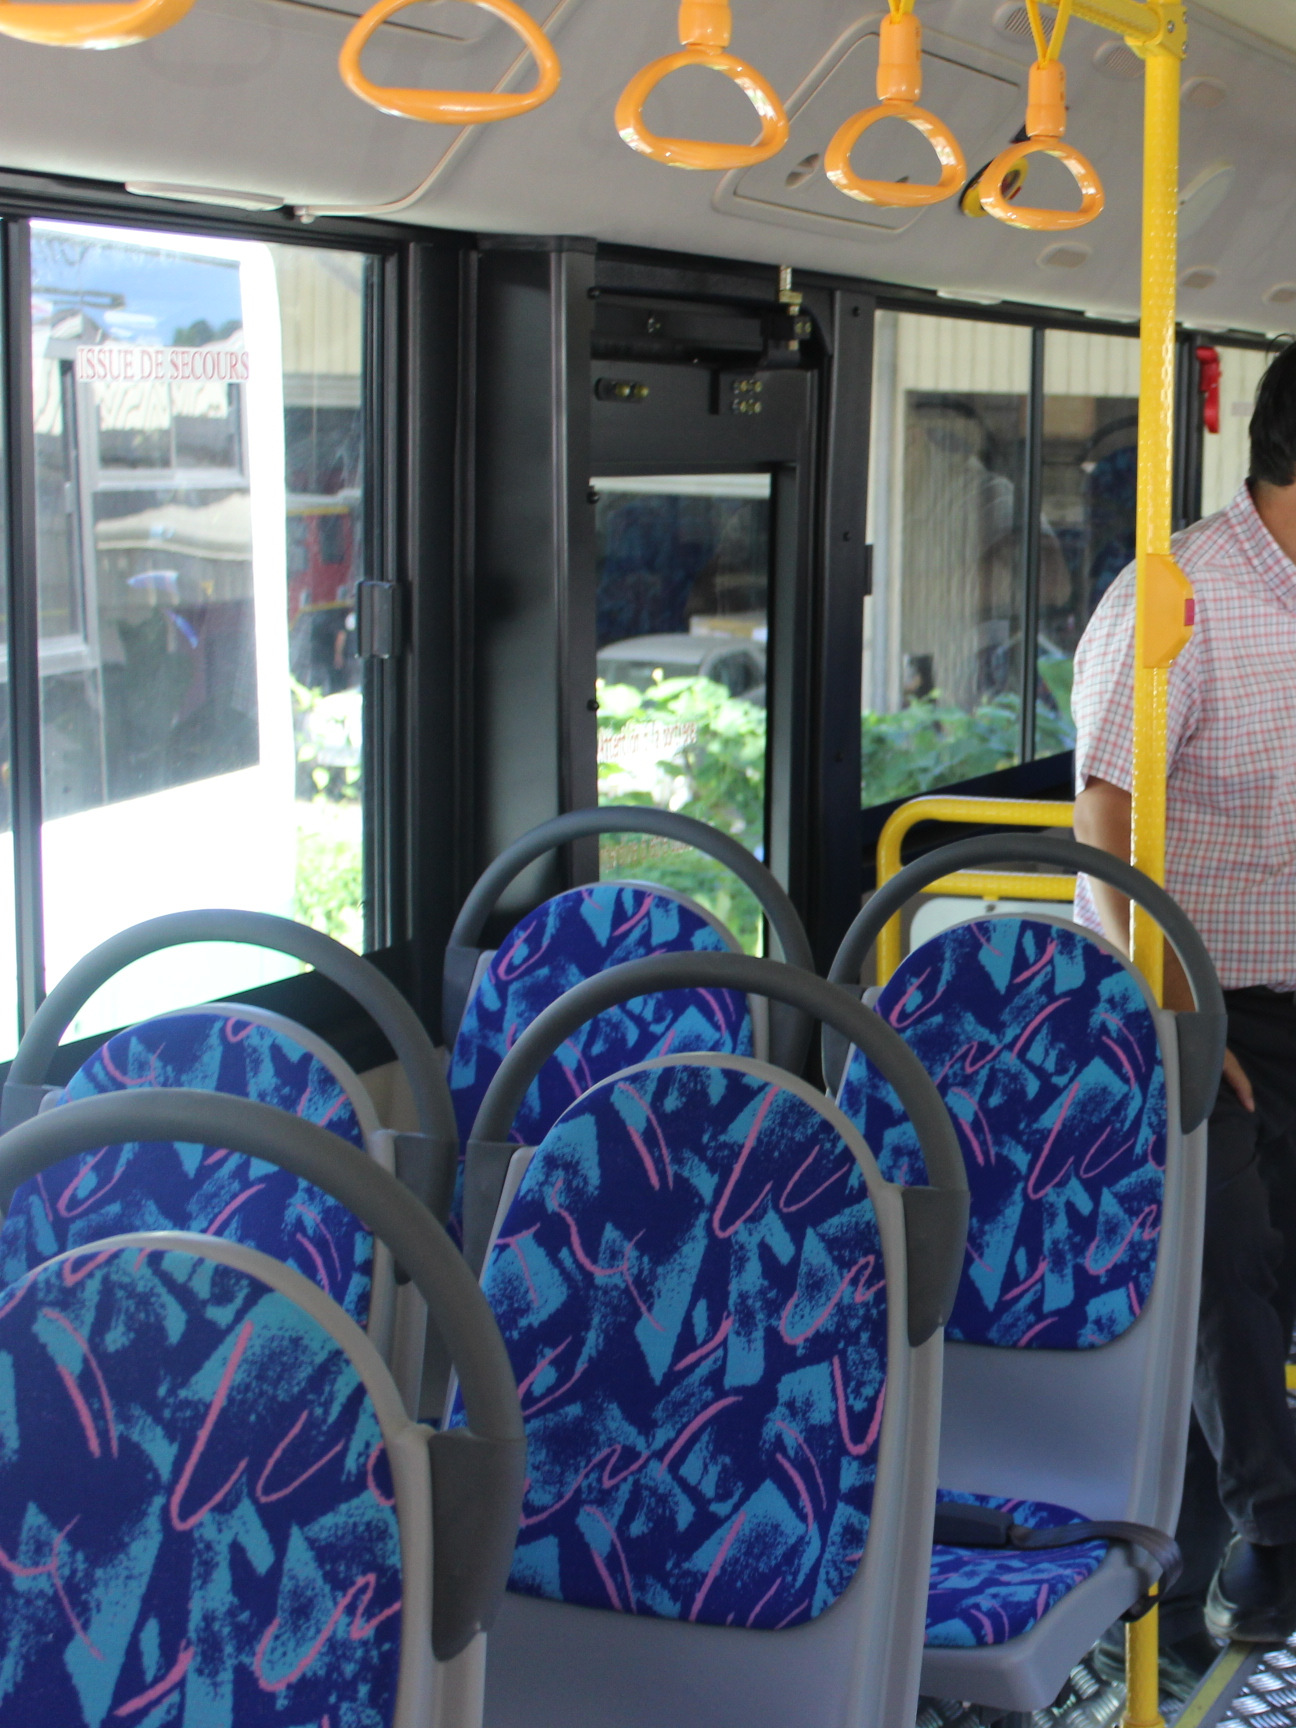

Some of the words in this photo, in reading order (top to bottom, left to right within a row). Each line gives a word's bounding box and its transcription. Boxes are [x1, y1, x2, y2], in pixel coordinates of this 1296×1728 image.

[79, 348, 135, 380] ISSUE
[140, 350, 166, 380] DE
[169, 351, 249, 381] SECOURS
